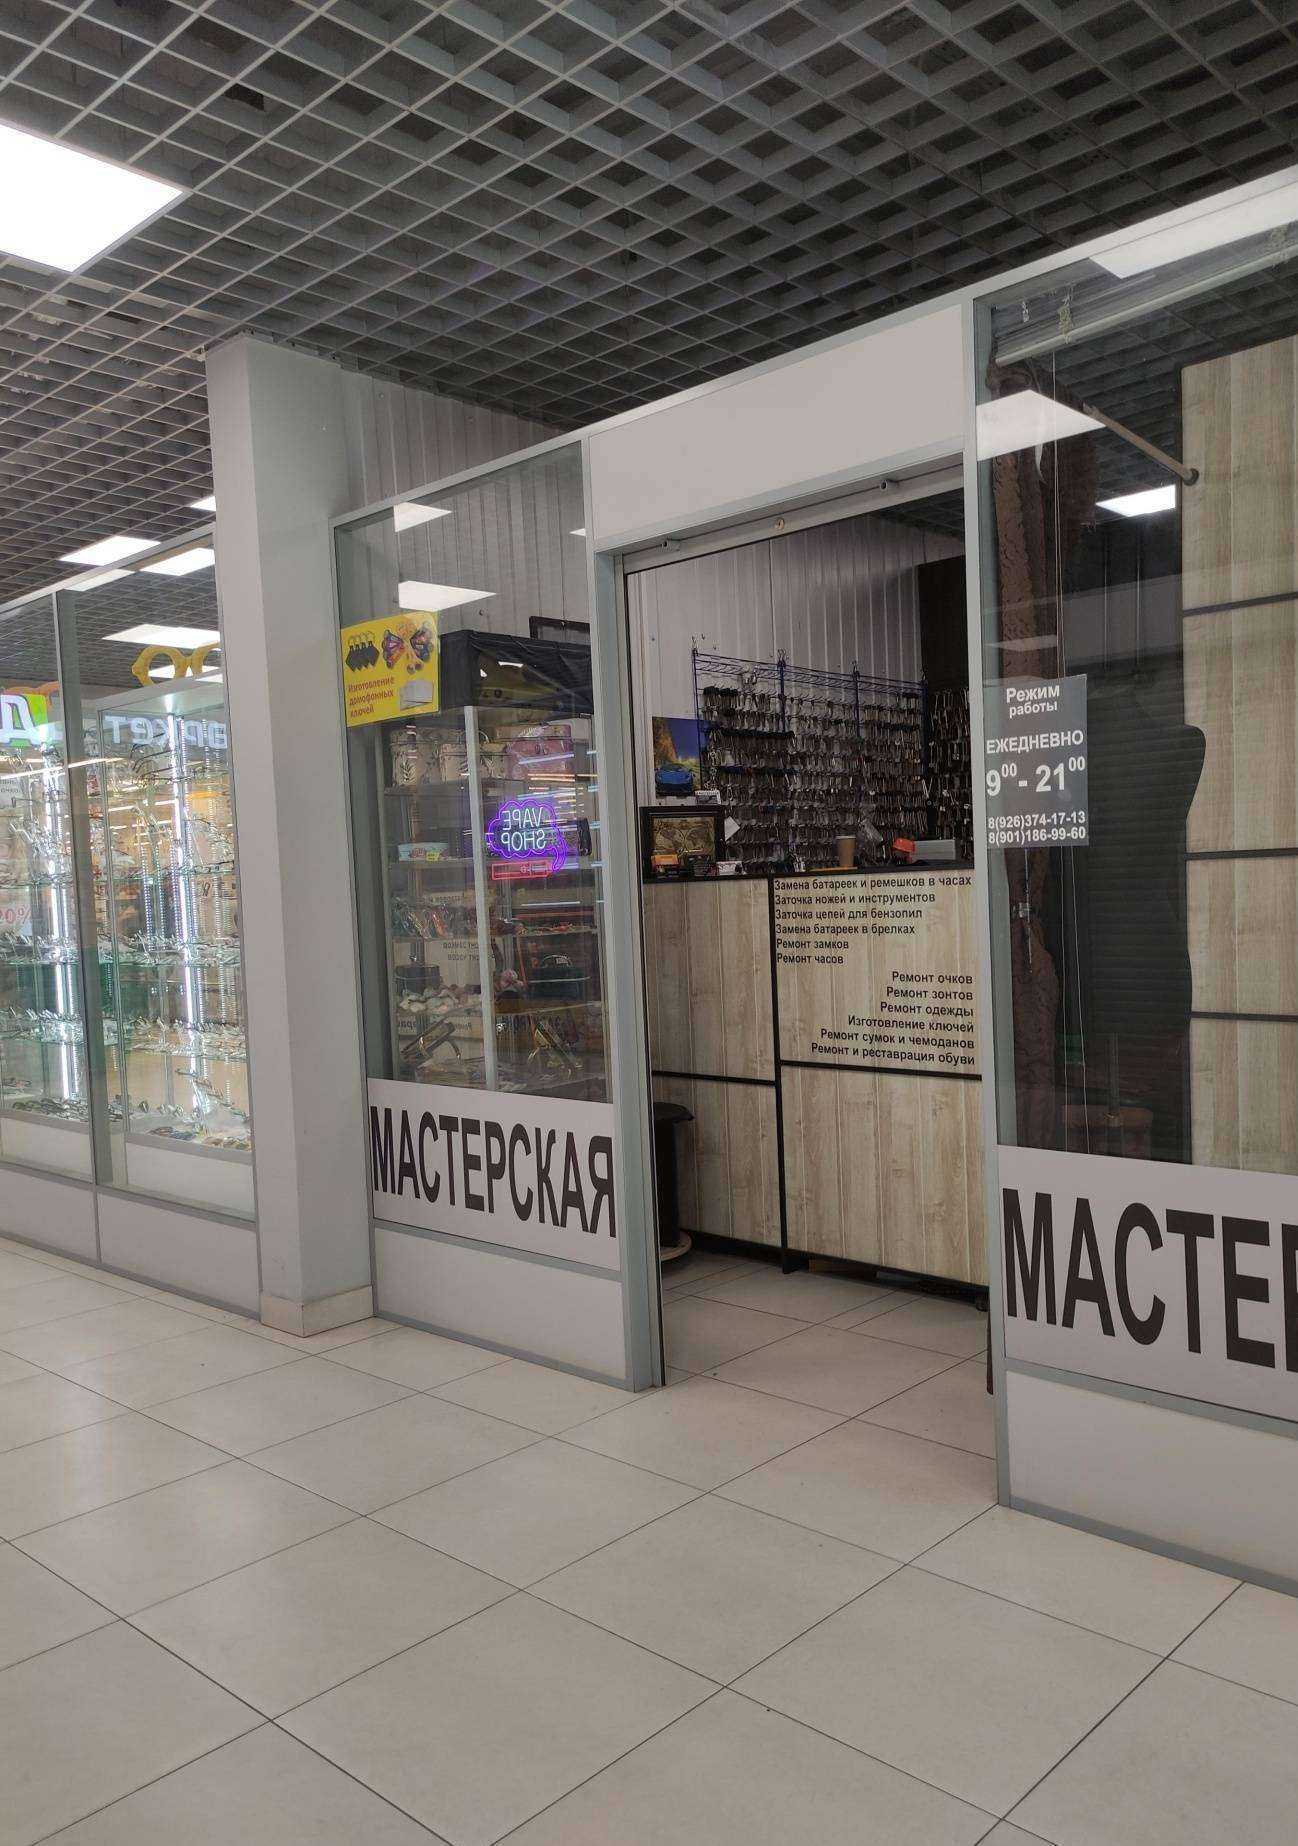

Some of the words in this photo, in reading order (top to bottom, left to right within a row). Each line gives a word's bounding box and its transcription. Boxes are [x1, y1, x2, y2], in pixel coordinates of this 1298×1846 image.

[1006, 685, 1060, 703] Режим
[1009, 701, 1058, 719] работы
[986, 730, 1084, 754] ЕЖЕДНЕВНО
[988, 811, 1086, 830] 8(926)374-17-13
[988, 826, 1086, 847] 8(901)186-99-60
[775, 880, 810, 890] Замена
[813, 879, 857, 892] батареек
[870, 878, 925, 890] ремешков
[939, 876, 972, 885] часах
[775, 895, 812, 905] Заточка
[816, 894, 846, 904] ножей
[859, 894, 935, 907] инструментов
[775, 910, 813, 919] Заточка
[816, 908, 845, 920] цепей
[848, 910, 868, 920] для
[871, 908, 922, 918] бензопил
[776, 924, 811, 934] Замена
[814, 924, 859, 935] батареек
[872, 924, 915, 935] брелках
[776, 939, 810, 949] Ремонт
[814, 940, 849, 949] замков
[777, 953, 811, 963] Ремонт
[815, 955, 843, 964] часов
[893, 971, 934, 983] Ремонт
[938, 975, 973, 983] очков
[887, 986, 928, 998] Ремонт
[932, 990, 973, 1000] зонтов
[881, 1002, 921, 1013] Ремонт
[926, 1006, 973, 1017] одежды
[849, 1015, 925, 1029] Изготовление
[929, 1021, 974, 1032] ключей
[821, 1028, 859, 1040] Ремонт
[862, 1034, 895, 1044] сумок
[899, 1036, 905, 1044] и
[909, 1037, 974, 1048] чемоданов
[811, 1043, 849, 1054] Ремонт
[853, 1047, 859, 1055] и
[862, 1047, 935, 1062] реставрация
[938, 1052, 974, 1066] обуви
[370, 1105, 617, 1239] МАСТЕРСКАЯ
